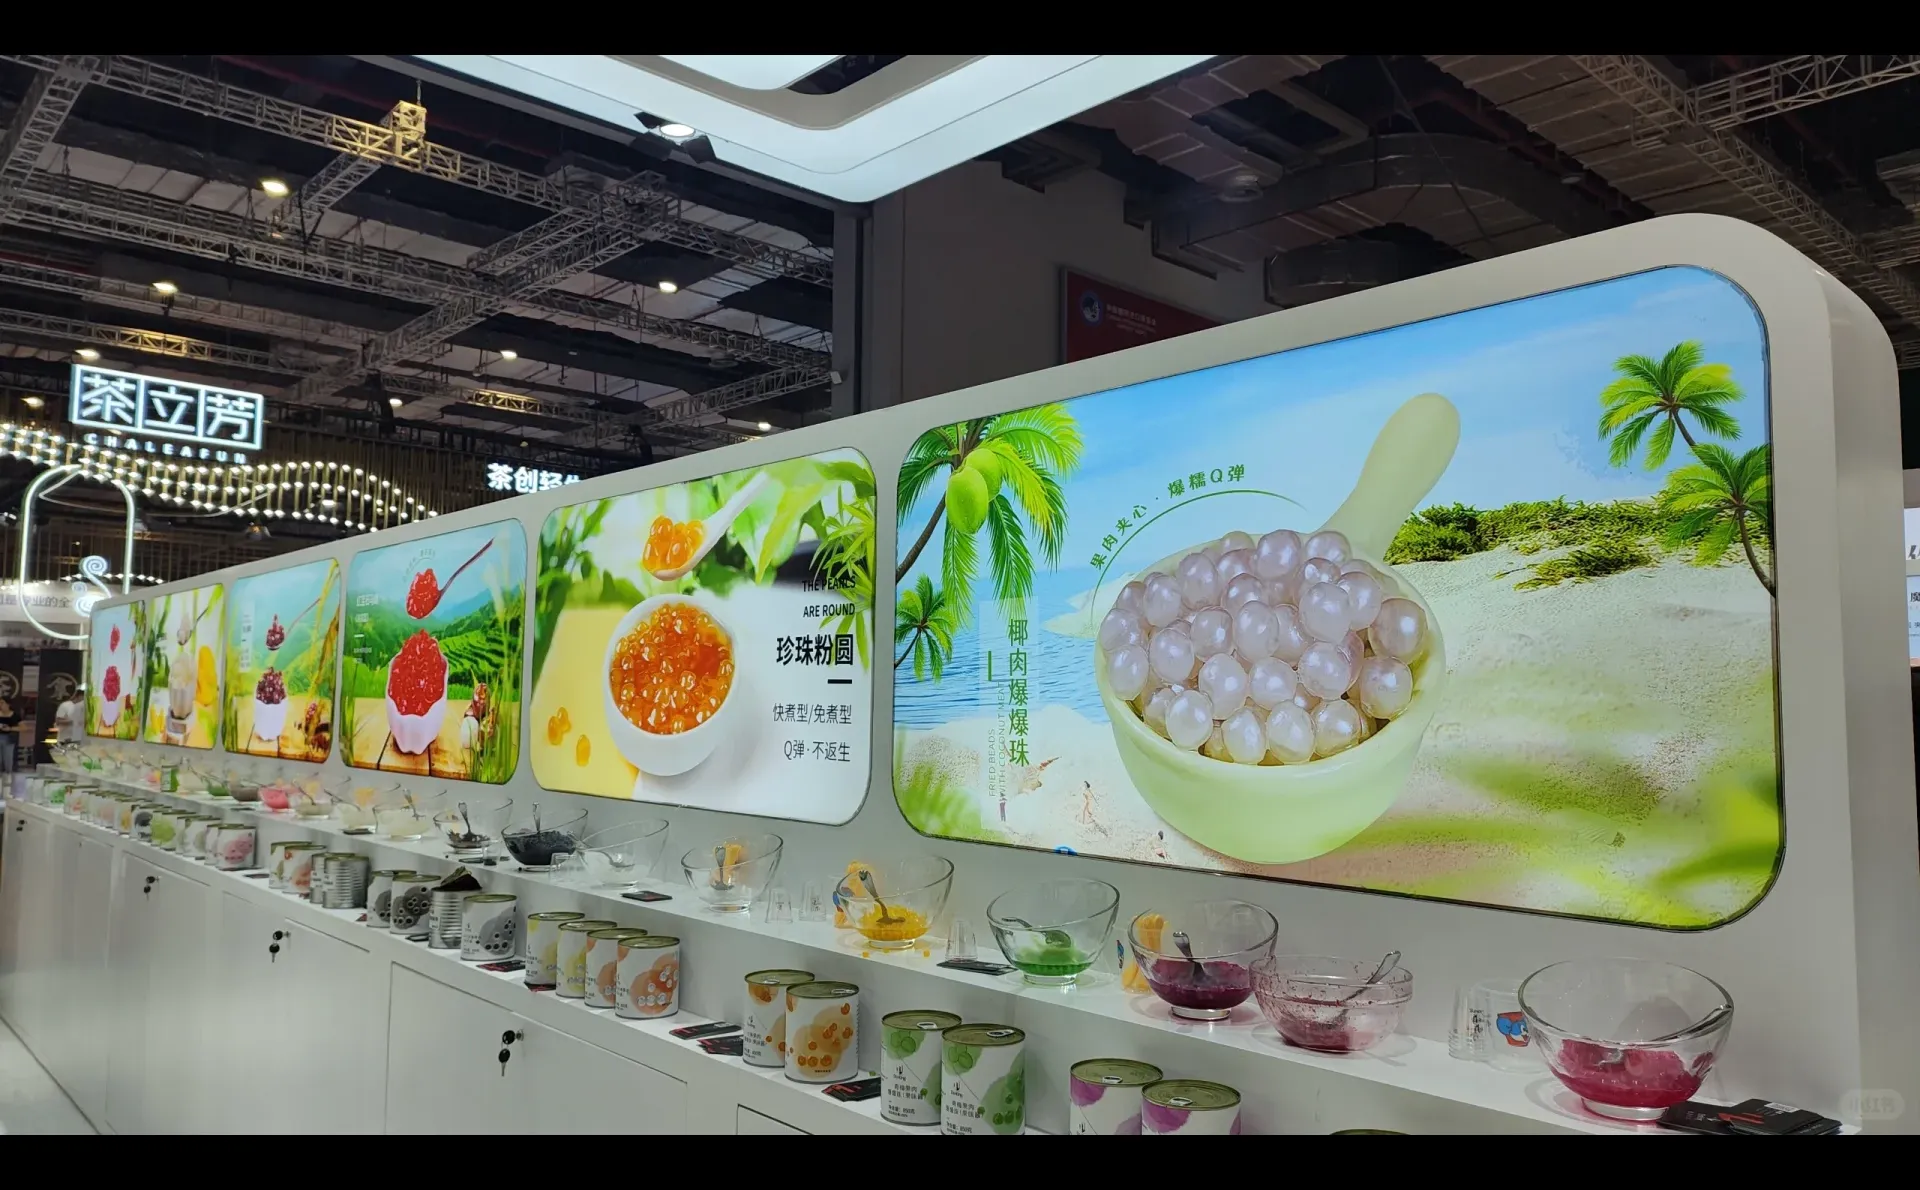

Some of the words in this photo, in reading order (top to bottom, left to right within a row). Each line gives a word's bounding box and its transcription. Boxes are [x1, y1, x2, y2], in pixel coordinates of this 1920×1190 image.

[81, 374, 256, 441] 茶立芳
[83, 432, 247, 465] CHALEAFUN
[802, 579, 820, 593] THE
[822, 575, 856, 591] PEARLS
[802, 604, 820, 618] ARE
[822, 602, 856, 617] ROUND
[776, 633, 854, 666] 珍珠粉圆
[1008, 618, 1030, 768] 椰肉爆爆珠
[772, 702, 852, 725] 快煮型/免煮型
[783, 739, 851, 762] Q弹·不返生
[988, 728, 996, 764] BEADS
[998, 713, 1006, 767] COCONUT
[988, 767, 996, 797] FRIED
